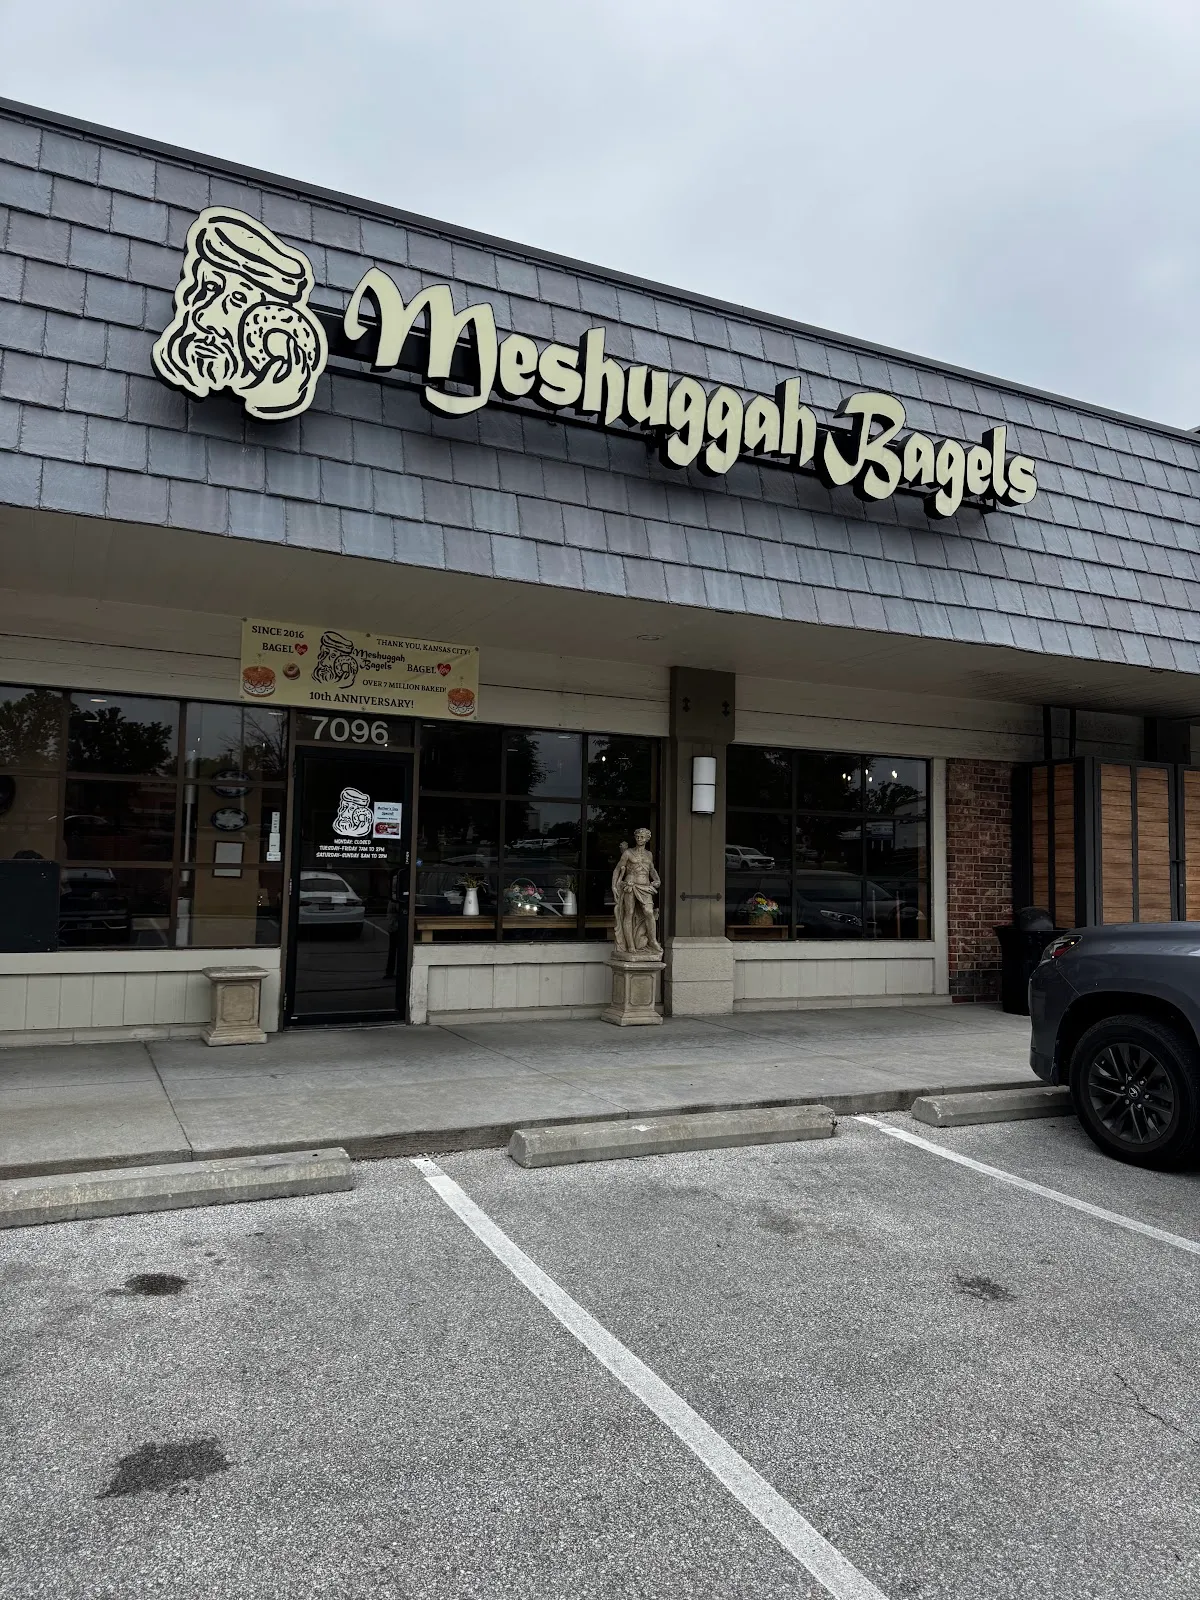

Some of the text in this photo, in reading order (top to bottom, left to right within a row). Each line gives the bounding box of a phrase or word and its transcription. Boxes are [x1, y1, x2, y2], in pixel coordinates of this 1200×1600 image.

[344, 266, 1037, 519] Meshuggah Bagels
[251, 625, 305, 639] SINCE 2016
[262, 642, 294, 654] BAGEL
[376, 638, 471, 655] THANK YOU, KANSAS CITY!
[352, 648, 406, 663] Meshuggah
[359, 658, 392, 672] Bagels
[407, 664, 436, 674] BAGEL
[362, 679, 383, 688] OVER
[388, 682, 420, 691] MILLION
[421, 685, 447, 693] BAKED!
[309, 691, 414, 709] 10th ANNIVERSARY!
[311, 716, 389, 745] 7096
